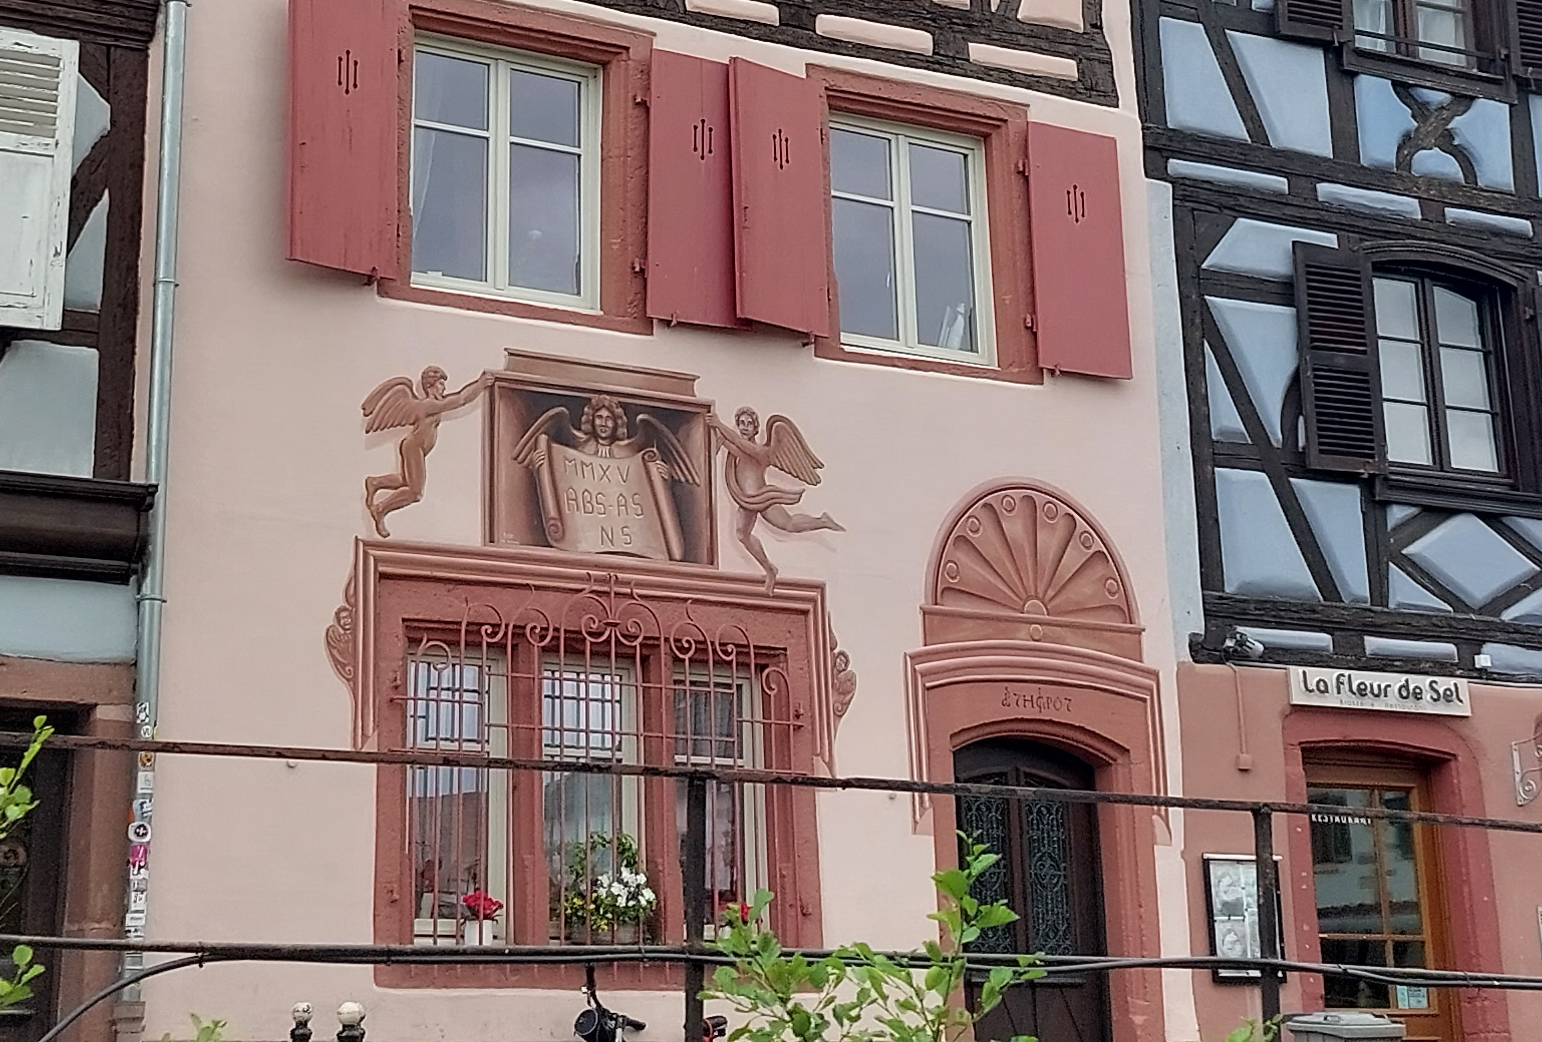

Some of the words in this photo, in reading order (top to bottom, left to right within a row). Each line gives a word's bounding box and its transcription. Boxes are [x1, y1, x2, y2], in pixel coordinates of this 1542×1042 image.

[1301, 669, 1330, 695] La
[1397, 677, 1424, 701] de
[1428, 679, 1464, 704] Sel
